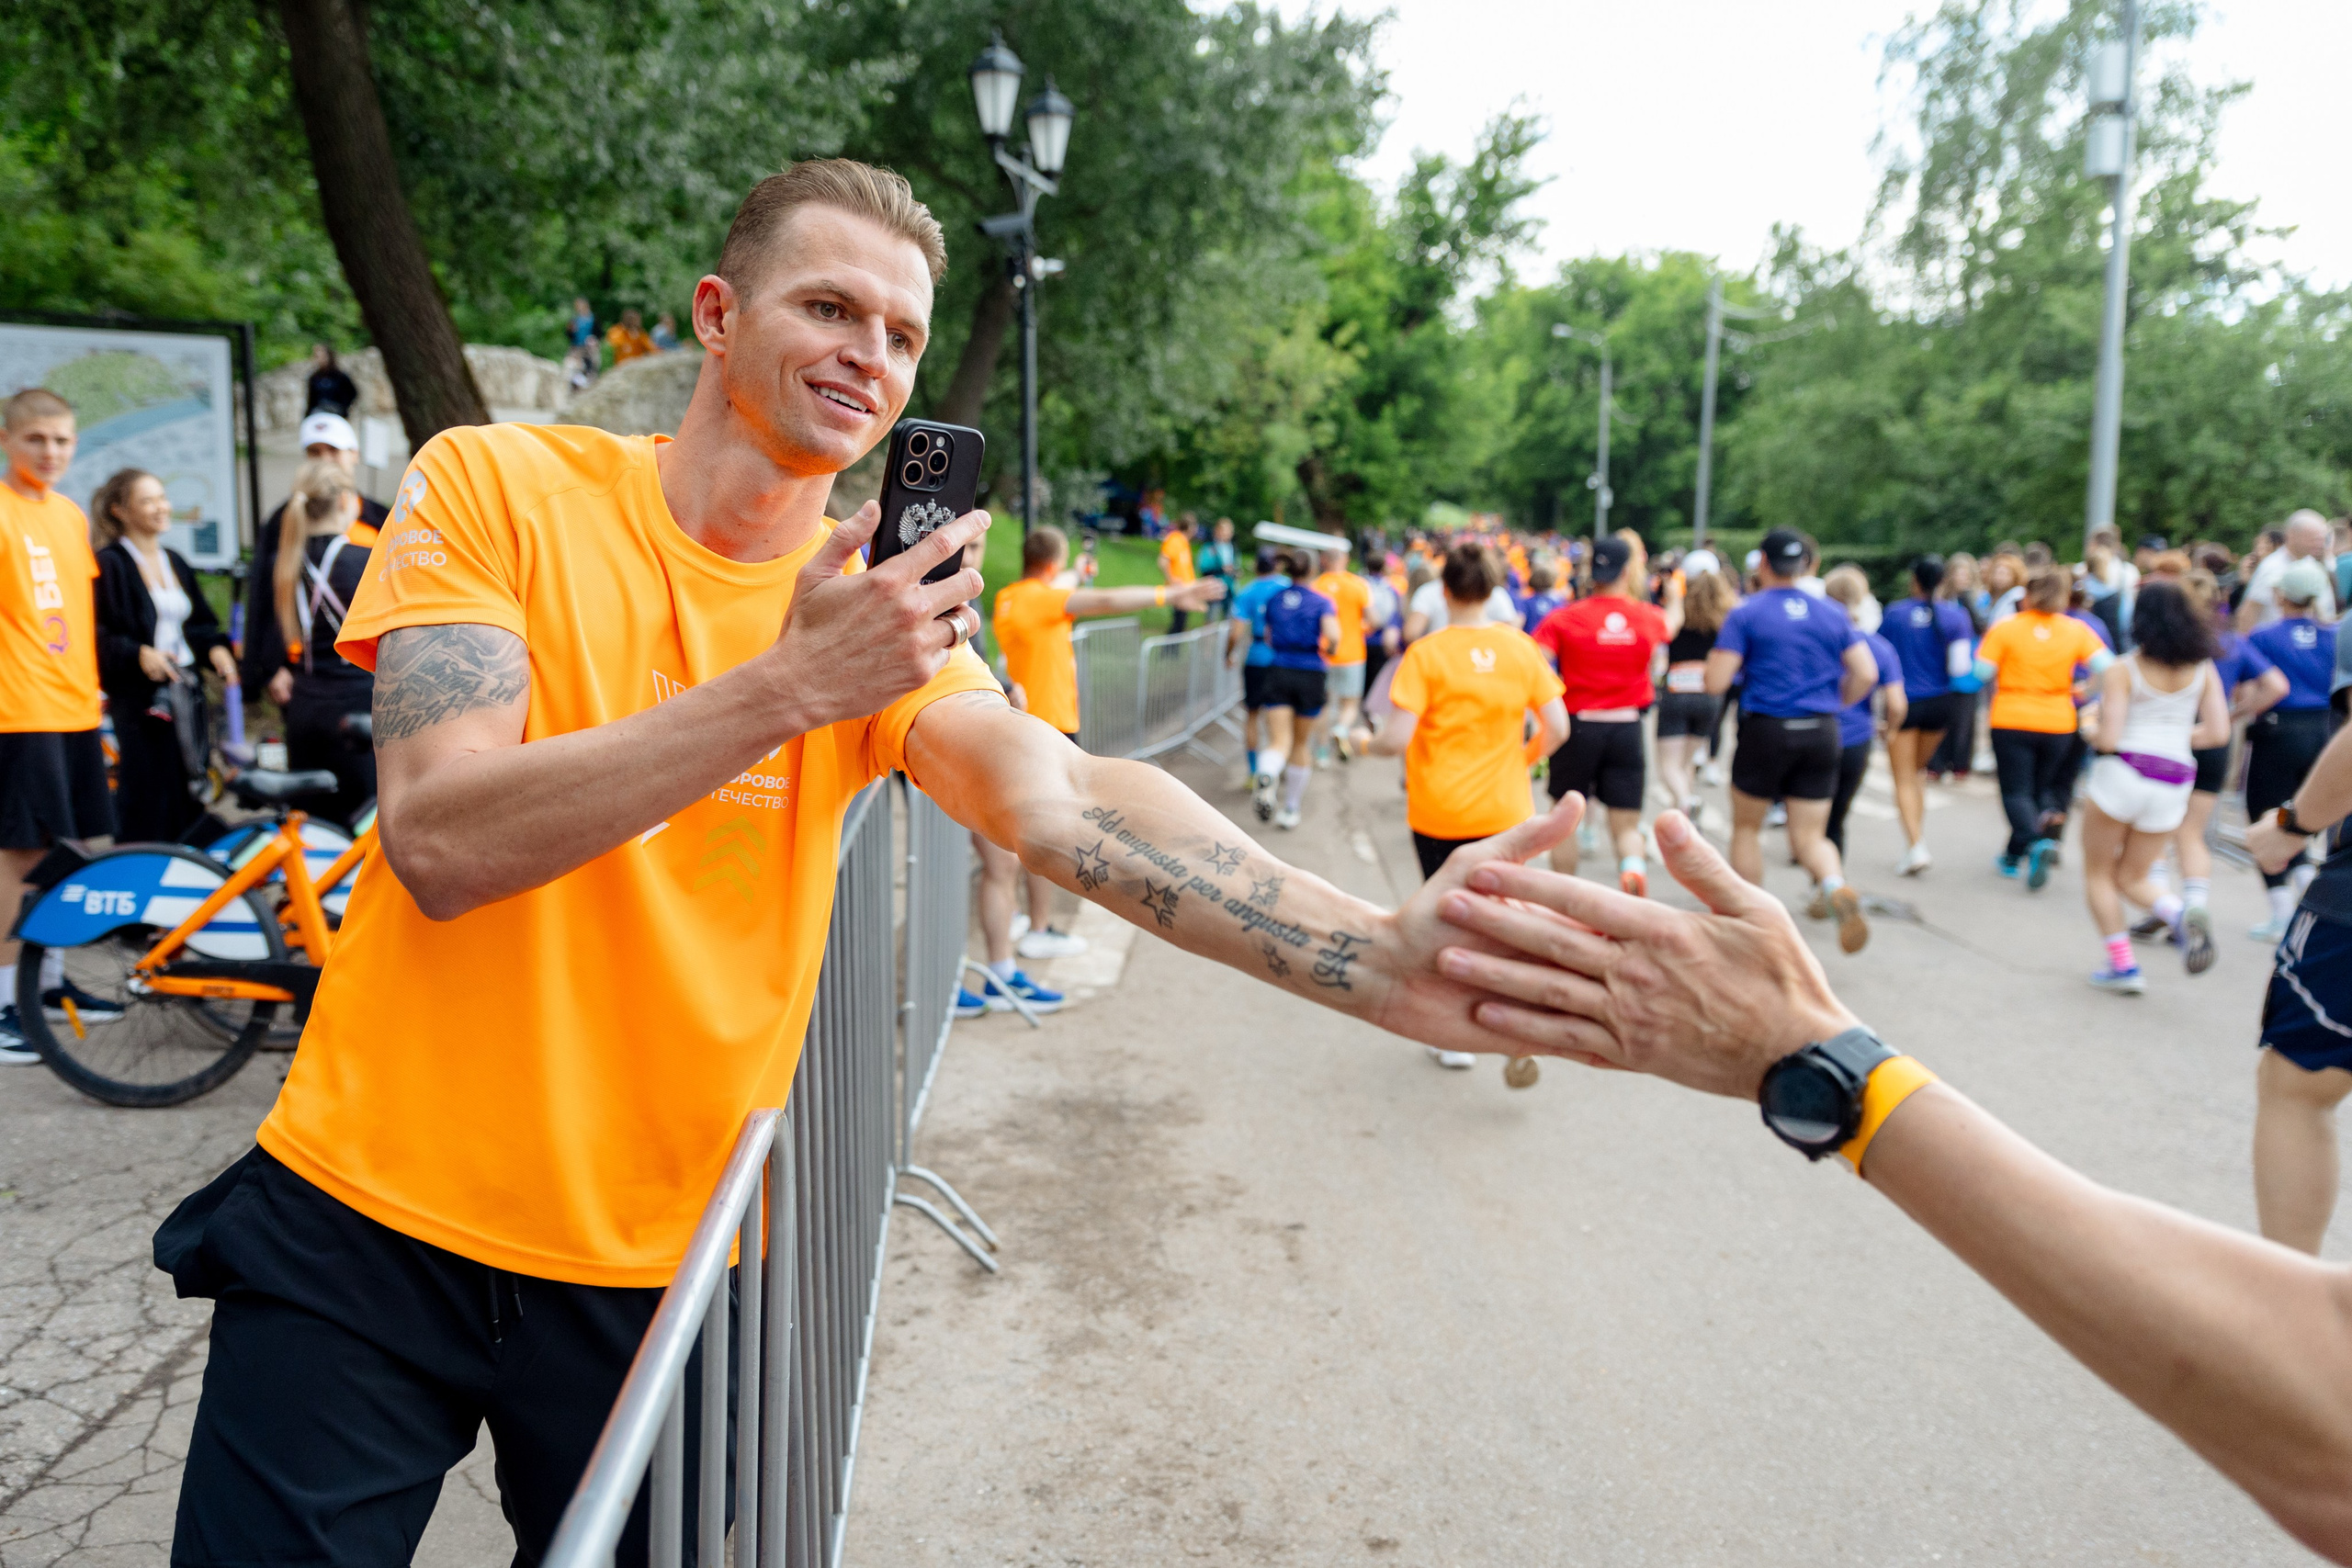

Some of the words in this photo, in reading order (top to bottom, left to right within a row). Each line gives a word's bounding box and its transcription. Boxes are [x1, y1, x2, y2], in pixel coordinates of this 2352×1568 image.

[84, 888, 137, 916] ВТБ
[1081, 807, 1125, 834] Ad
[1115, 829, 1188, 878] augusta
[1177, 874, 1223, 903] per
[1223, 897, 1311, 949] angusta
